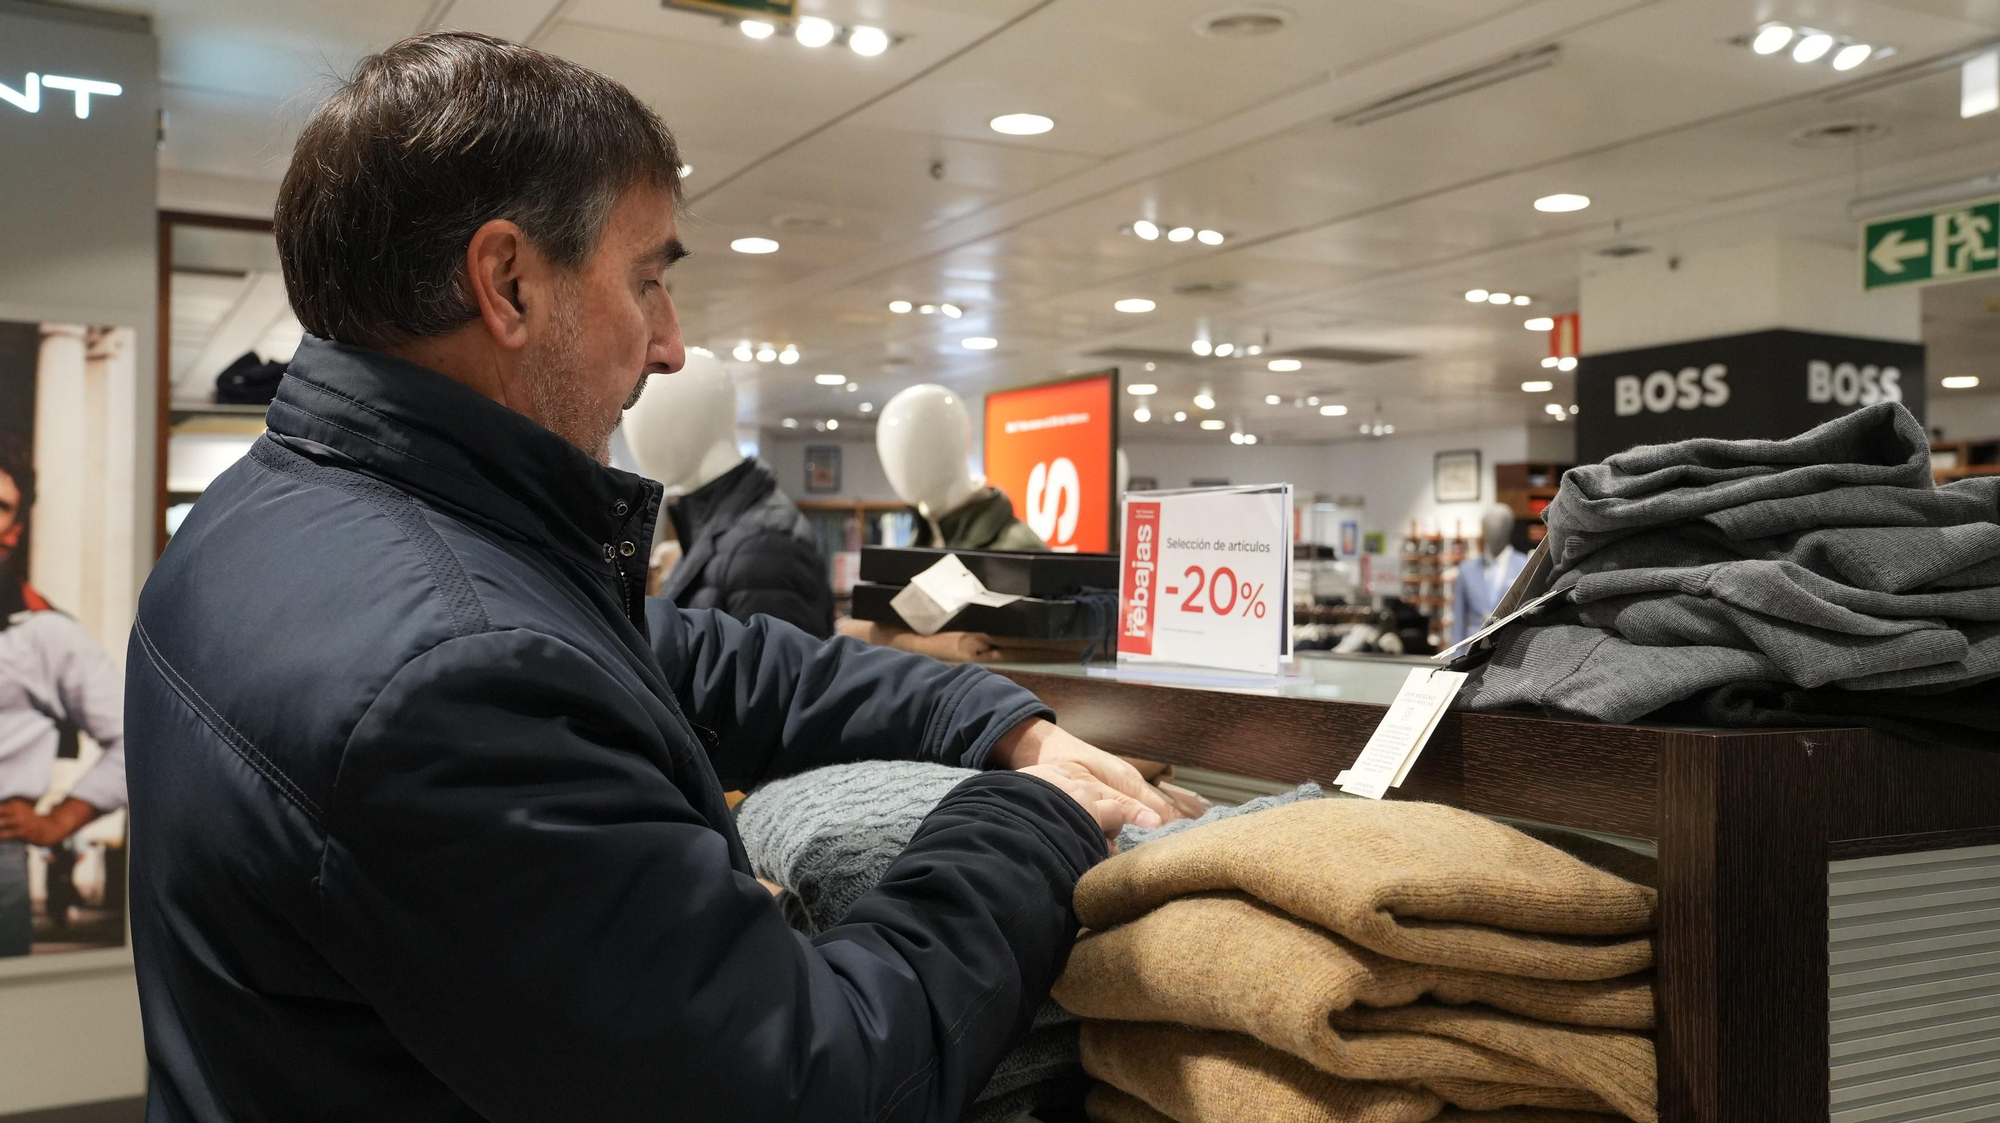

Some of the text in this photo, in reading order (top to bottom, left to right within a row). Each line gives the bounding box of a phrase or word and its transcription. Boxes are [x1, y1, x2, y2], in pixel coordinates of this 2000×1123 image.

[0, 72, 122, 119] NT
[1615, 363, 1730, 416] BOSS
[1807, 360, 1902, 406] BOSS
[1166, 537, 1270, 553] Selección de artículos
[1129, 524, 1154, 637] rebajas
[1165, 565, 1266, 619] -20%
